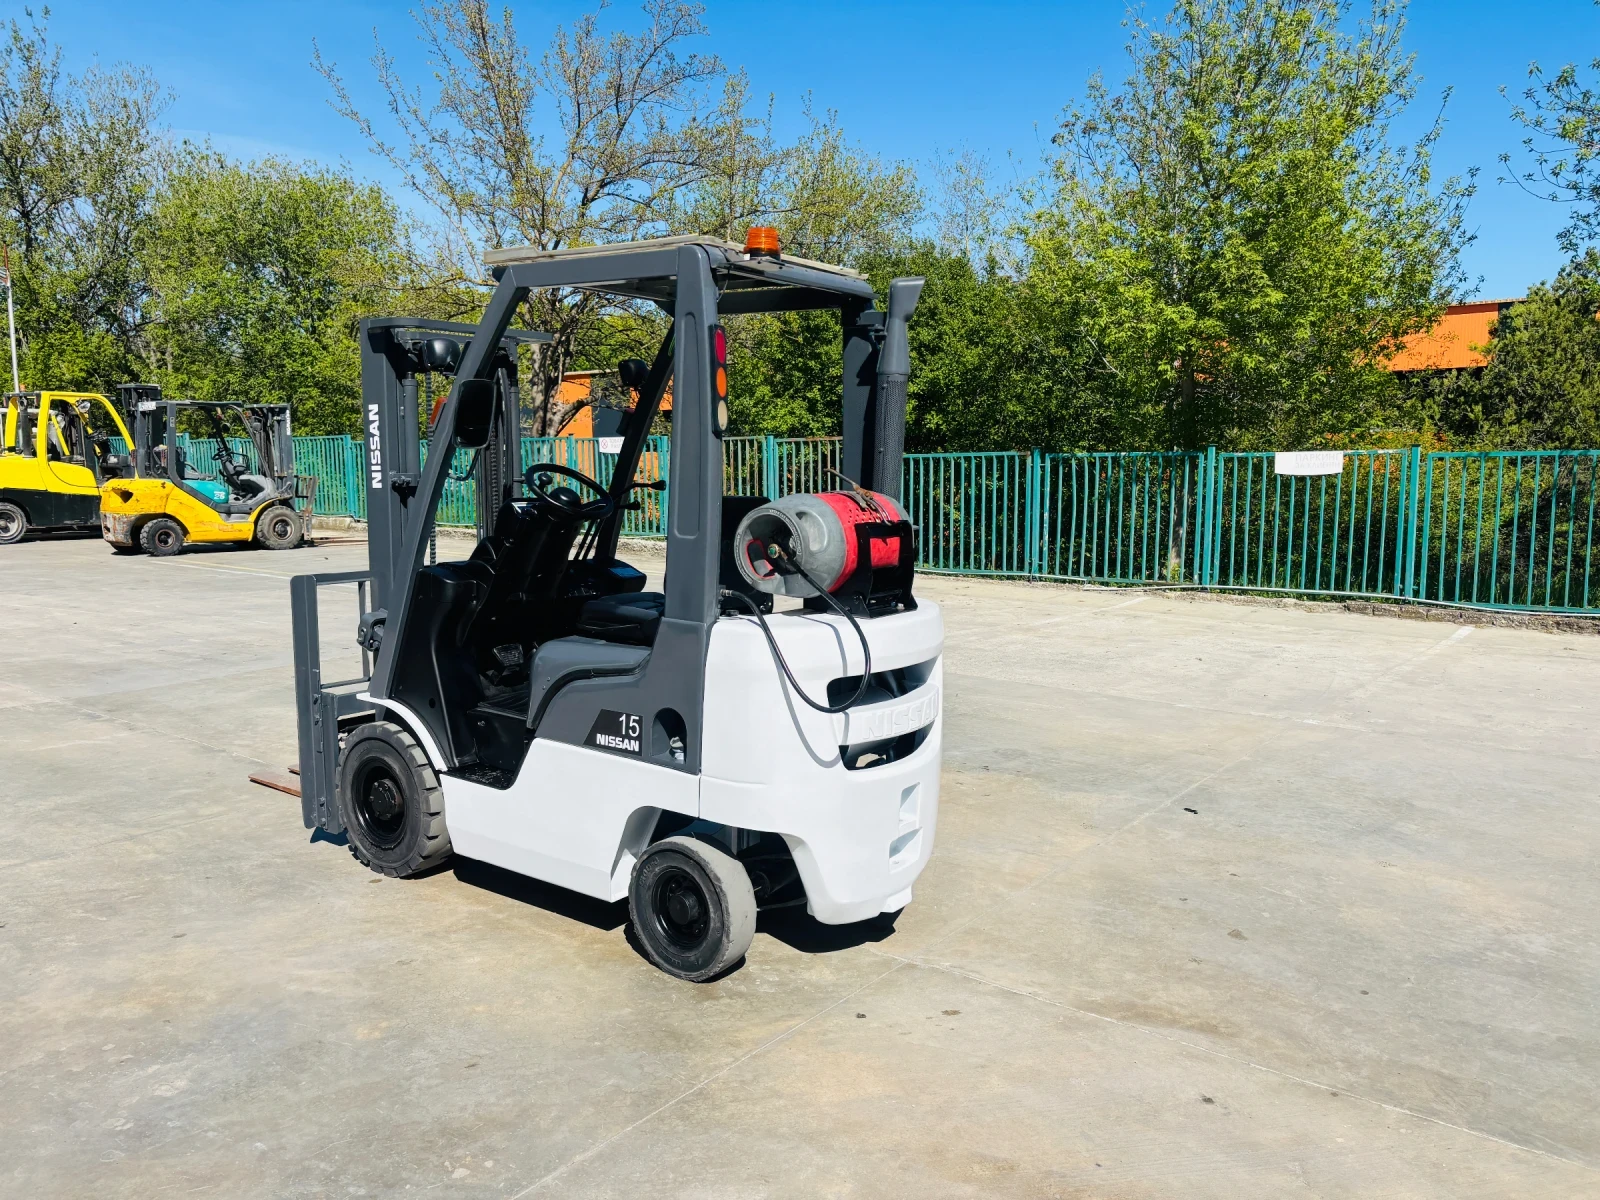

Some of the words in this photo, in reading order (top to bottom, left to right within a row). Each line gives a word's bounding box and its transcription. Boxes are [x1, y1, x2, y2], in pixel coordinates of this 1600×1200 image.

[368, 403, 383, 489] NISSAN
[1295, 453, 1341, 462] ПАРКИНГ
[619, 713, 640, 737] 15
[596, 733, 640, 752] NISSAN
